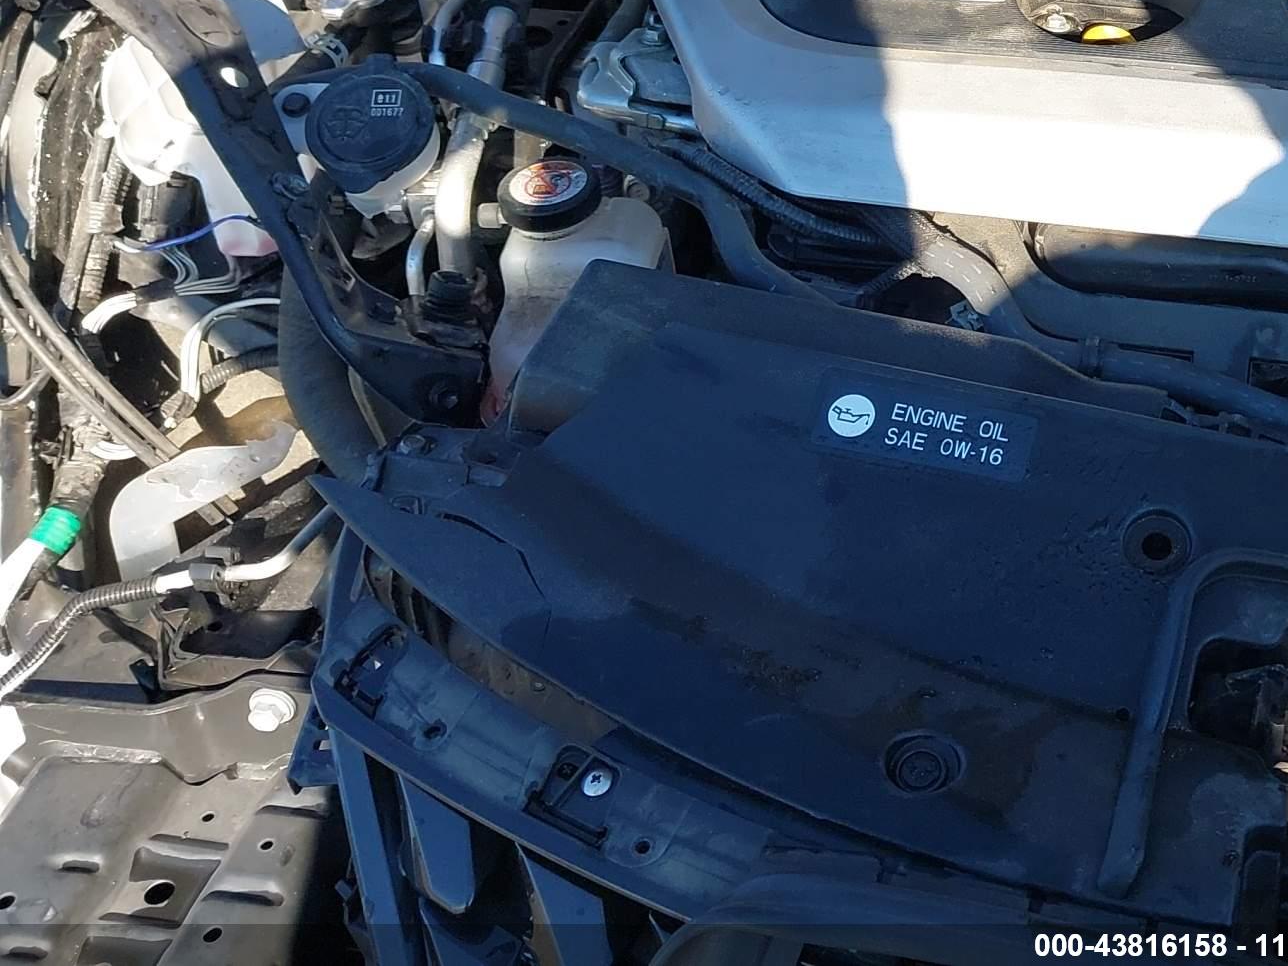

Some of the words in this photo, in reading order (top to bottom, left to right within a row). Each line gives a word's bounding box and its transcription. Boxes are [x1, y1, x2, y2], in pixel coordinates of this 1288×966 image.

[891, 402, 967, 433] ENGINE
[979, 420, 1009, 442] OIL
[884, 427, 928, 451] SAE
[940, 438, 1004, 465] 0W-16
